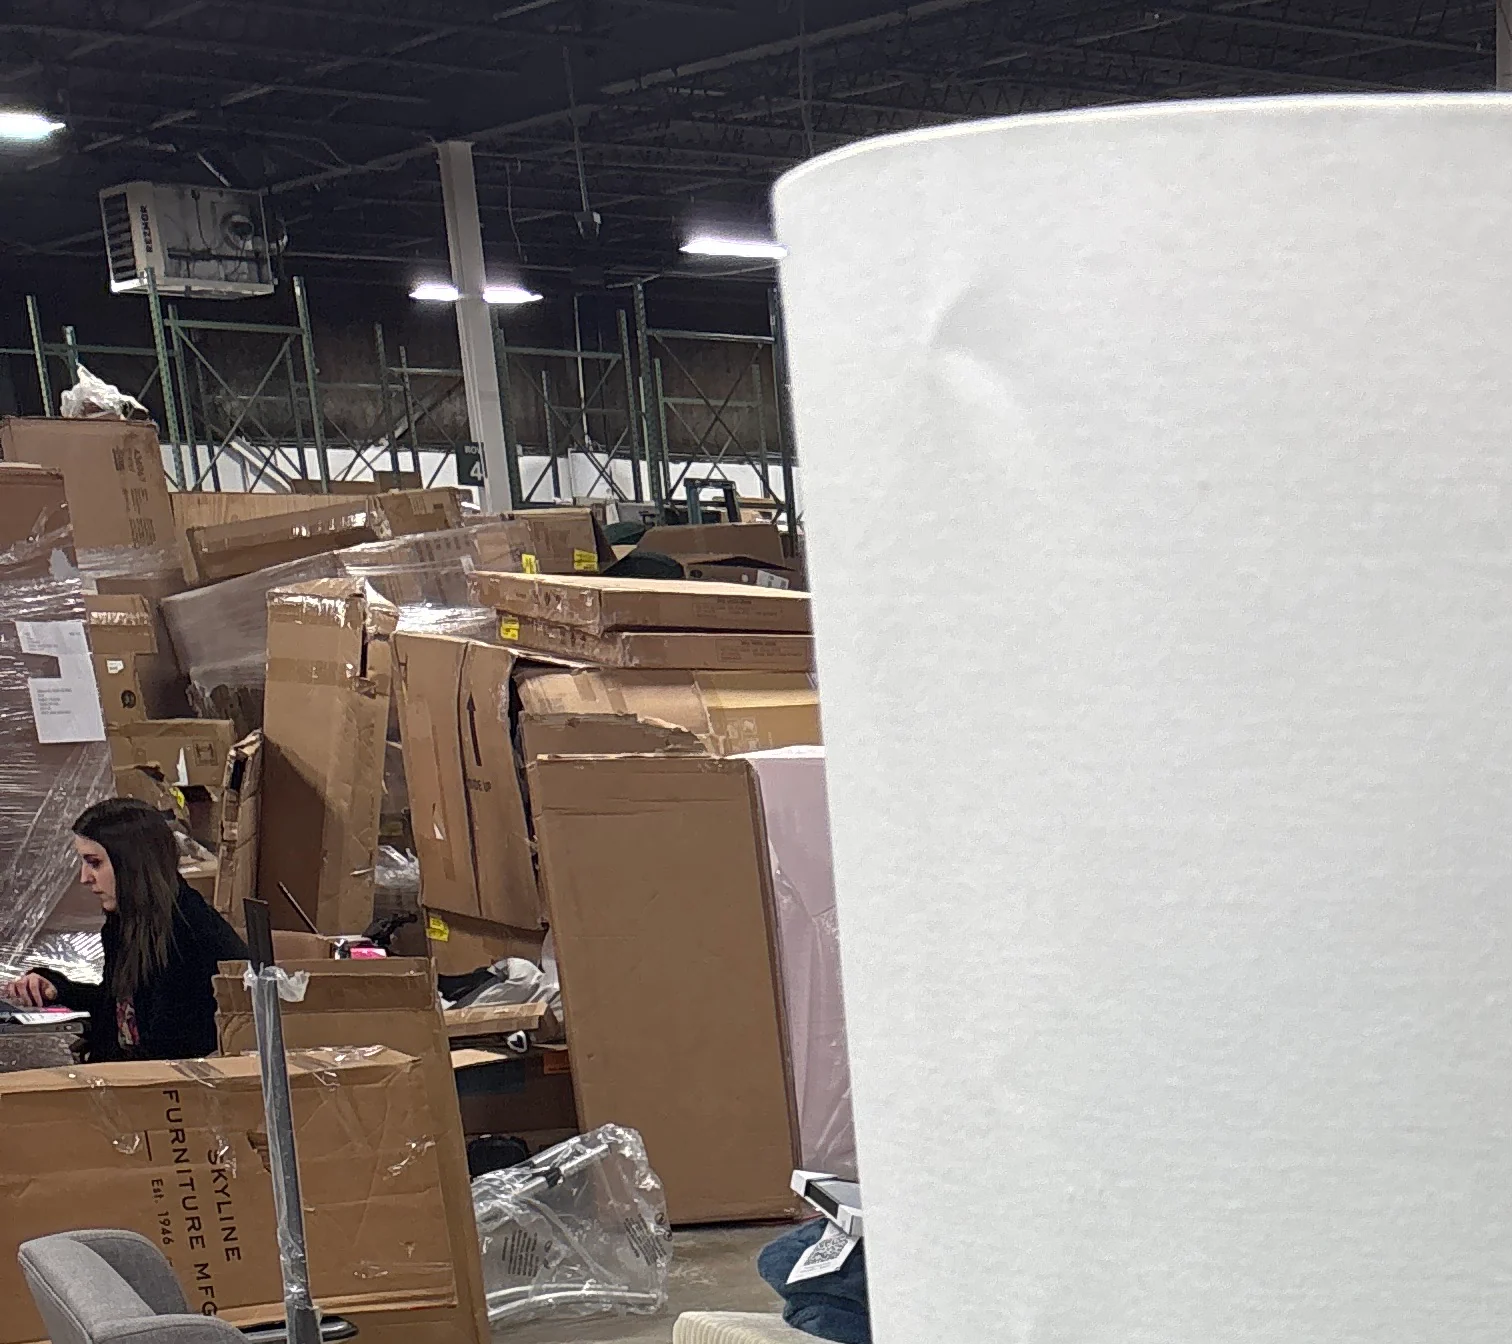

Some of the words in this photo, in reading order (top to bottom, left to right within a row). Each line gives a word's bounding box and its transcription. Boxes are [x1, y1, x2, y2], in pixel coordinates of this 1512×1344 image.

[470, 461, 484, 481] 4
[151, 1178, 164, 1204] Est.
[158, 1211, 174, 1246] 1946
[163, 1089, 206, 1251] FURNITURE
[194, 1262, 218, 1317] MFG
[208, 1149, 242, 1262] SKYLINE
